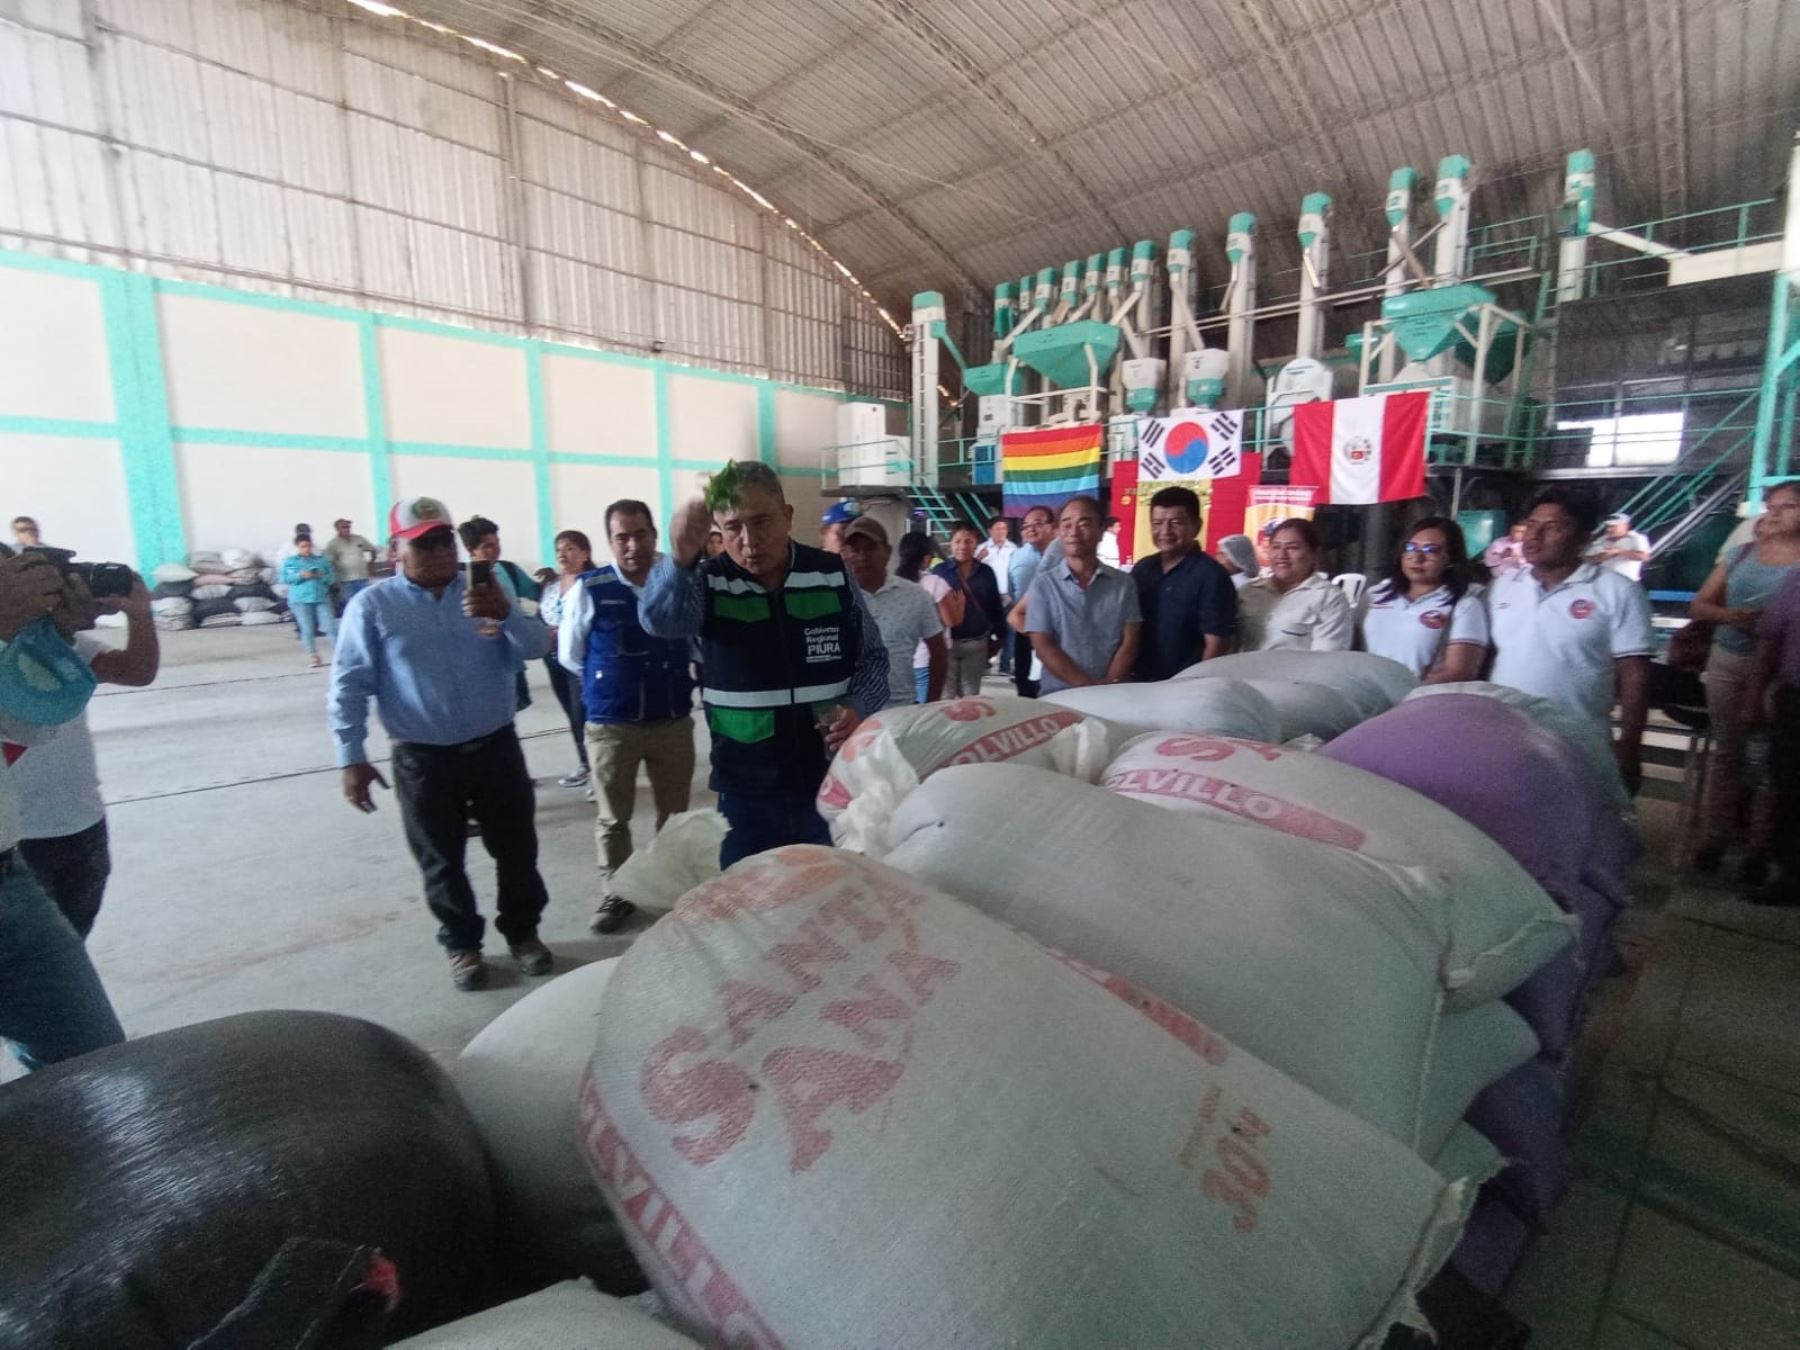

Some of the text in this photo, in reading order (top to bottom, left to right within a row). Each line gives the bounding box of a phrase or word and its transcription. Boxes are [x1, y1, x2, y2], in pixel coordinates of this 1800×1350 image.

[807, 641, 841, 656] PIURA
[950, 718, 1059, 765] OLVILLO
[1102, 768, 1281, 820] OLVILLO
